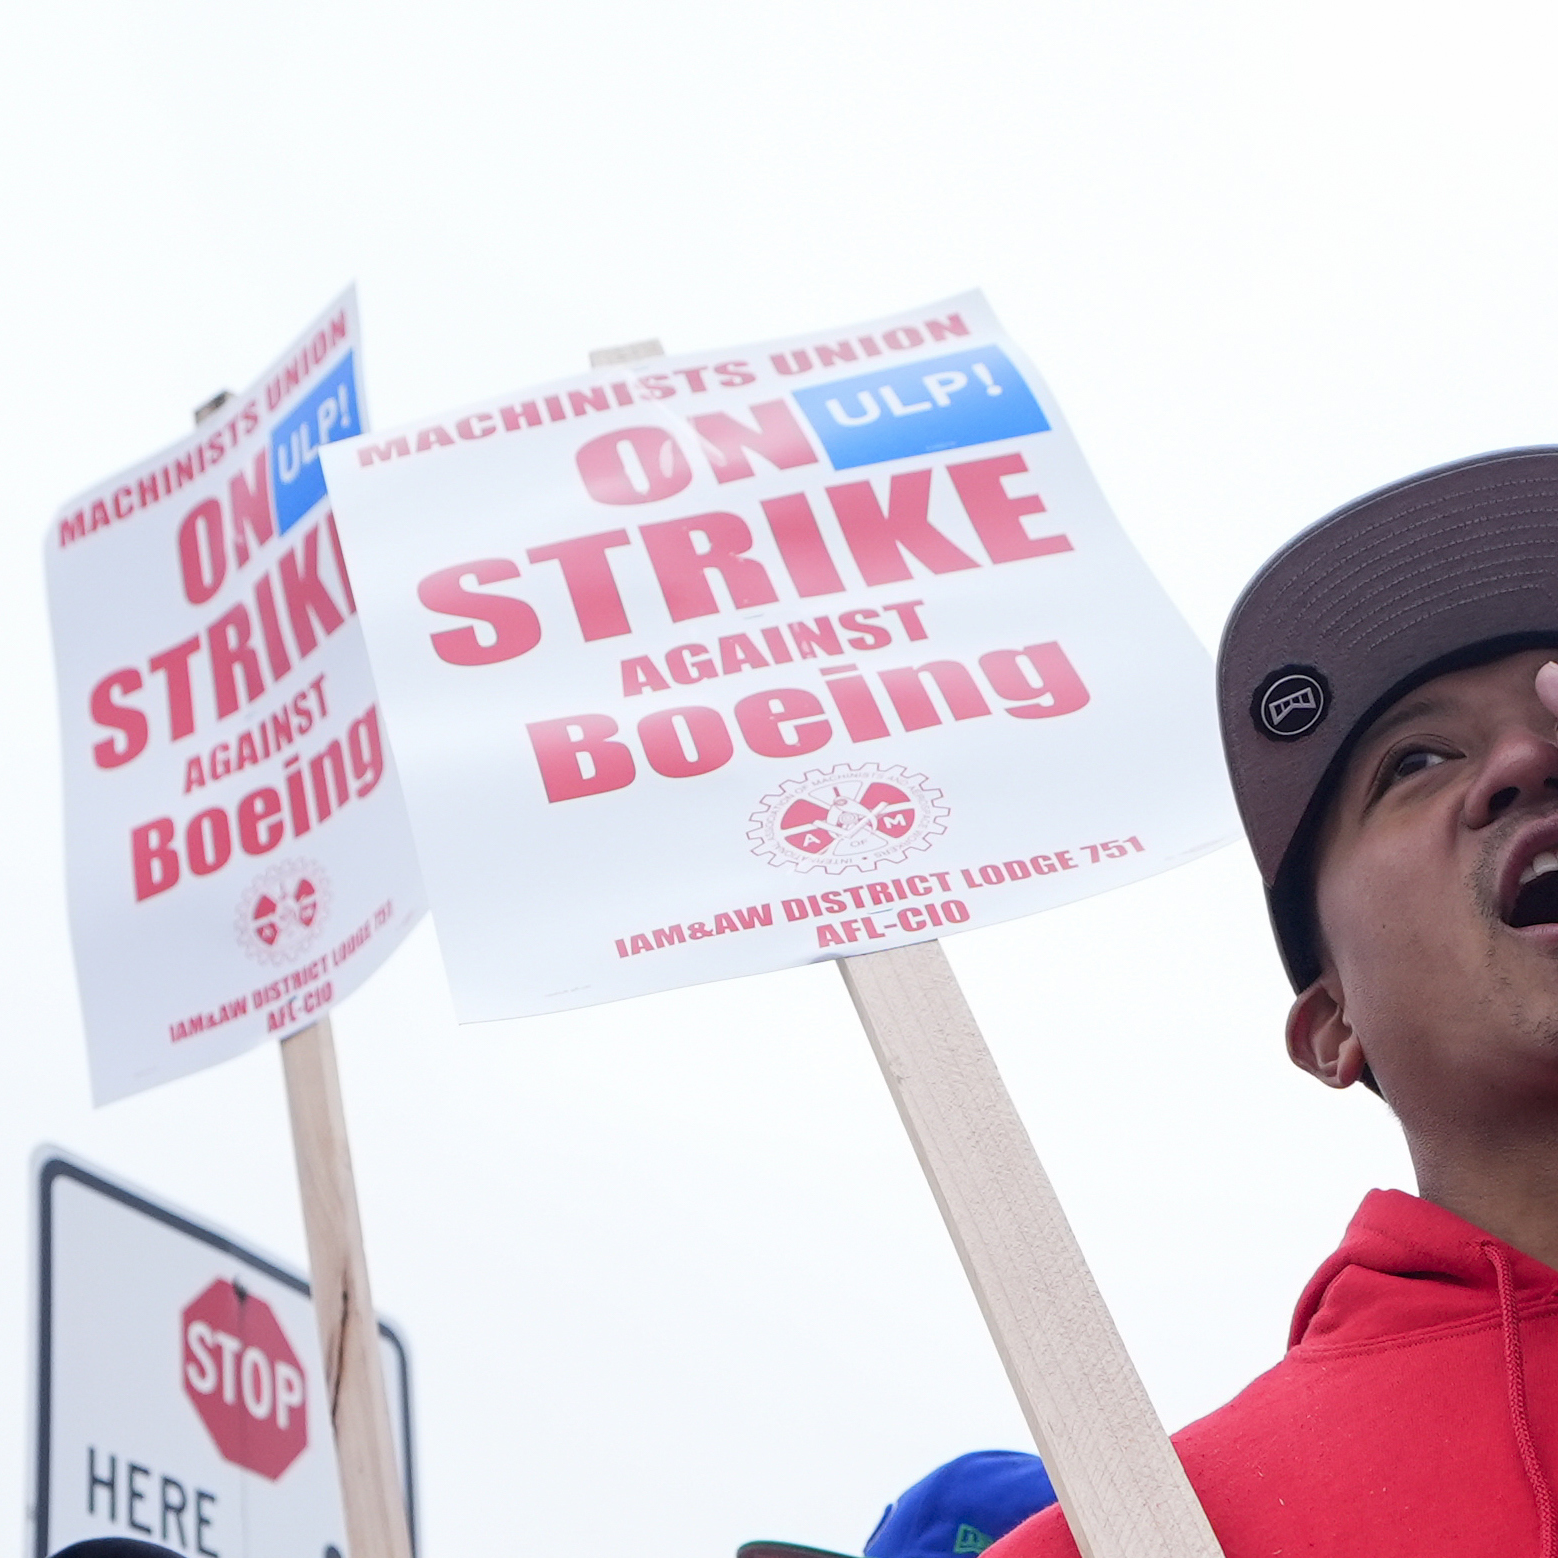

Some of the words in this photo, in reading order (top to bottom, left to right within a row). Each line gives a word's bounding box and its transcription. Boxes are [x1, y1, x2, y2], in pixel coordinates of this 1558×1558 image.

[58, 399, 260, 549] MACHINISTS
[264, 306, 347, 411] UNION
[358, 358, 757, 468] MACHINISTS
[770, 312, 972, 379] UNION
[575, 397, 819, 507] ON
[825, 361, 1004, 426] ULP!
[177, 446, 276, 606] ON
[278, 382, 352, 484] ULP!
[416, 452, 1075, 667] STRIKE
[526, 639, 1092, 804] Boeing
[619, 599, 929, 698] AGAINST
[131, 703, 384, 903] Boeing
[183, 672, 328, 795] AGAINST
[614, 902, 774, 959] IAM&AW
[782, 871, 954, 926] DISTRICT
[961, 844, 1081, 890] LODGE
[1080, 835, 1147, 865] 751
[815, 898, 972, 950] AFL-CIO
[252, 953, 328, 1010] DISTRICT
[186, 1321, 304, 1431] STOP
